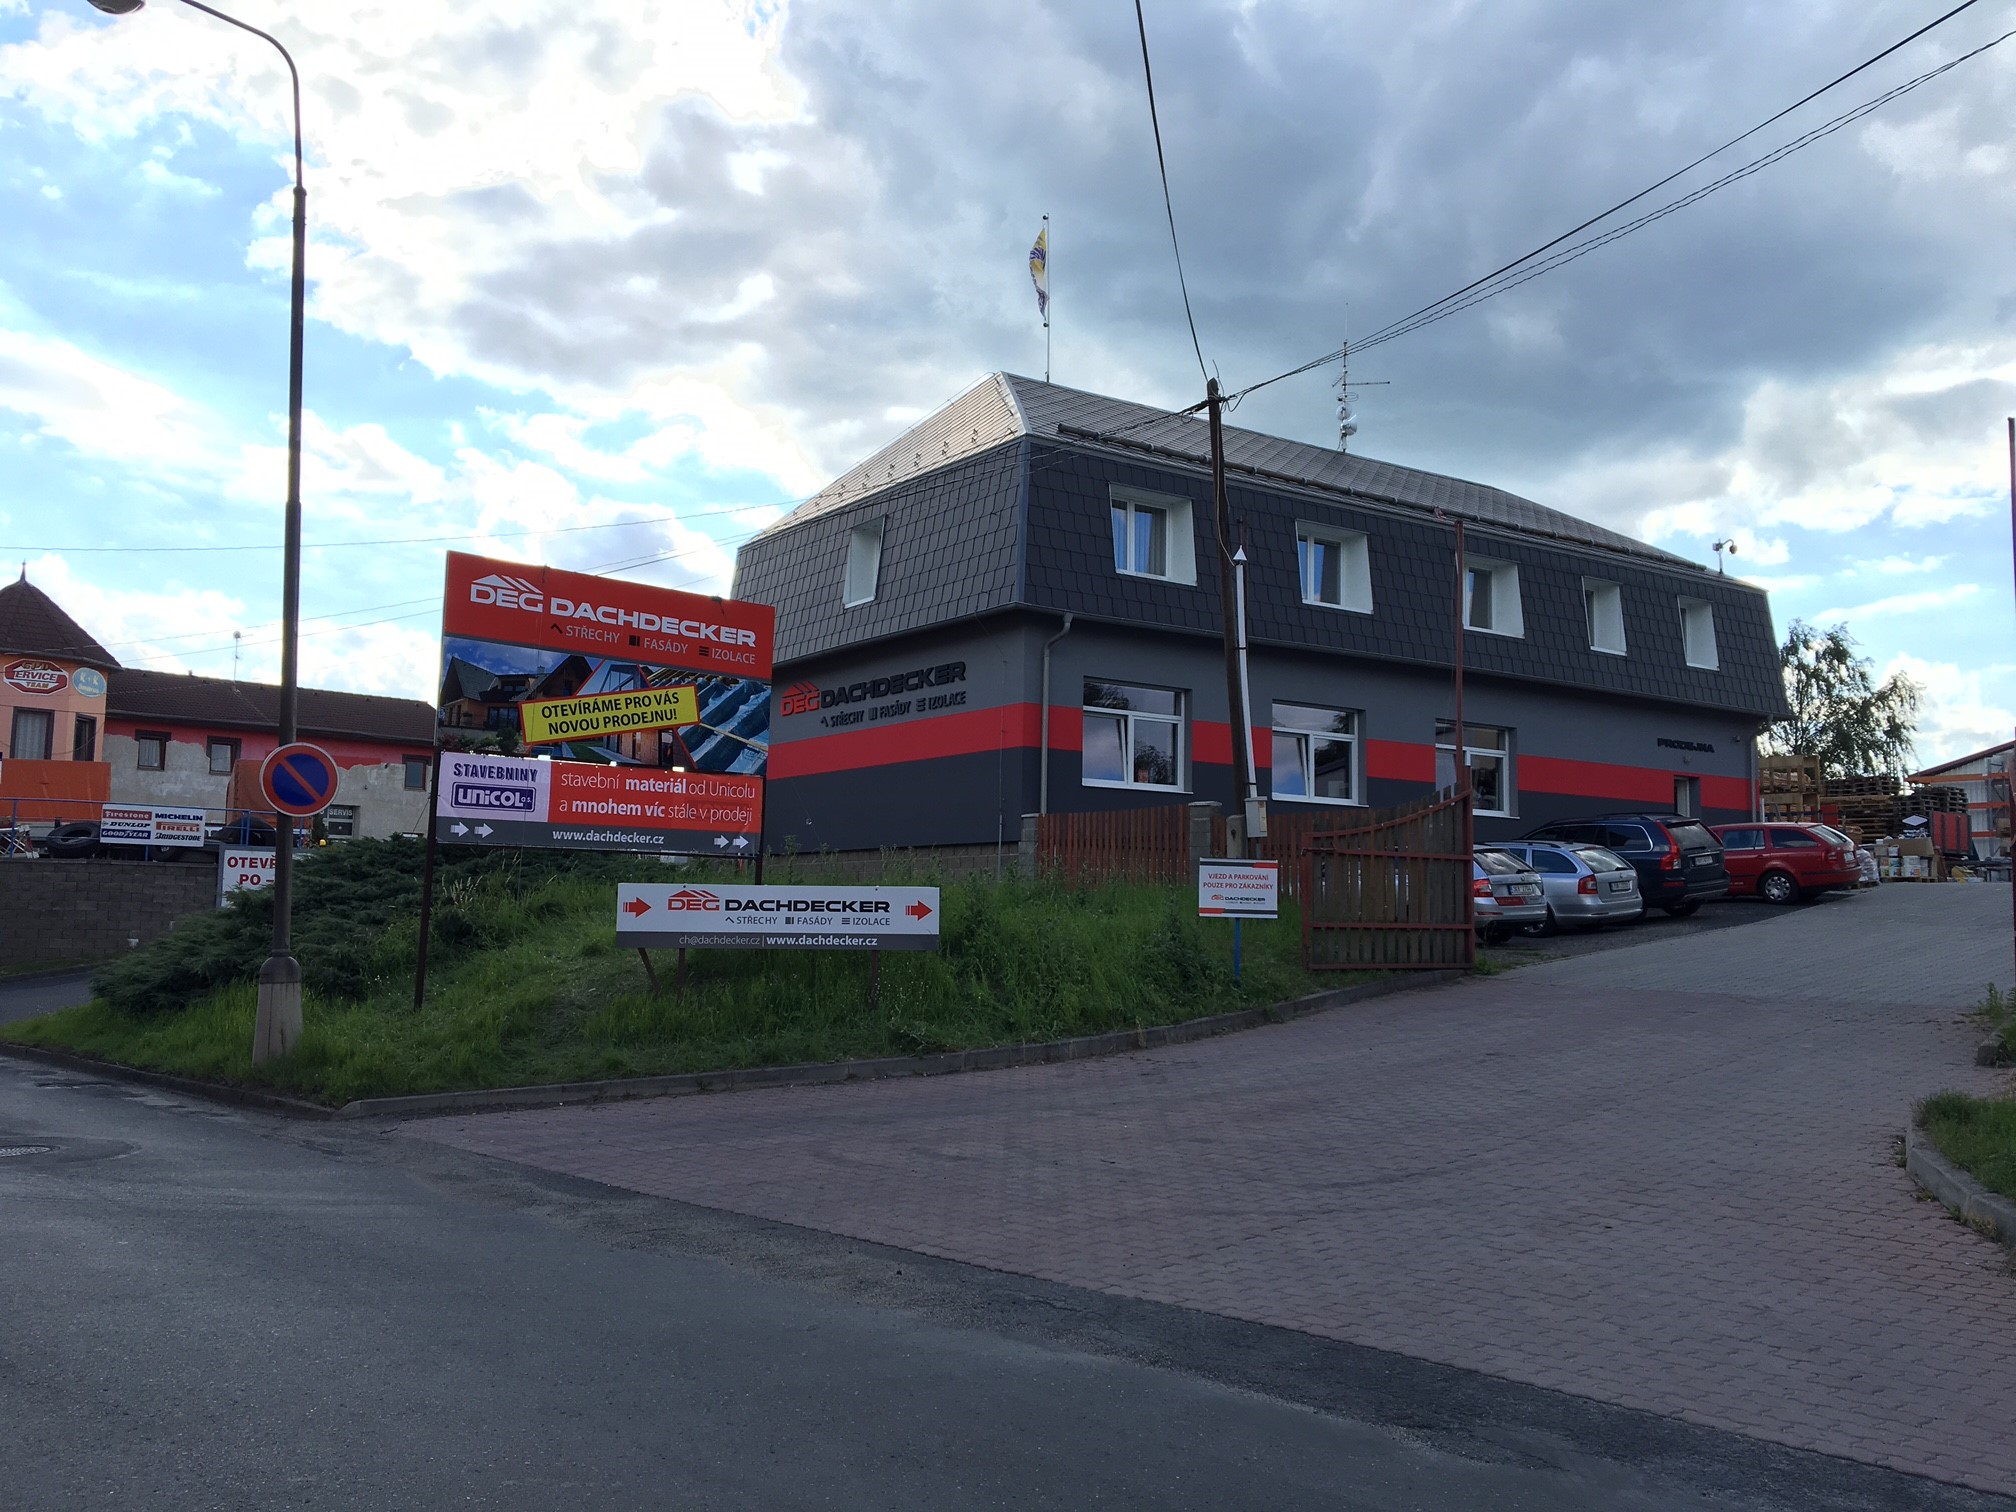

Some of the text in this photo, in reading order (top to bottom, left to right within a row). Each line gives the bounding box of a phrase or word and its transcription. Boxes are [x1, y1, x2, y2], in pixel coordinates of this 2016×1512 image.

[470, 583, 757, 648] DEG DACHDECKER
[565, 624, 756, 665] STŘECHY FASÁDY IZOLACE
[26, 681, 49, 689] TEAM
[780, 661, 967, 717] DEG DACHDECKER
[541, 692, 680, 719] OTEVÍRÁME PRO VÁS
[830, 690, 967, 728] STŘECHY FASÁDY IZOLACE
[548, 708, 678, 735] NOVOU PRODEJNU!
[453, 763, 538, 782] STAVEBNINY
[560, 772, 756, 799] stavební materiál od Unicolu
[104, 810, 150, 819] Firestone
[154, 813, 203, 821] MICHELIN
[328, 808, 353, 817] SERVIS
[559, 799, 754, 826] a mnohem víc stále v prodeji
[102, 830, 148, 838] GOODYEAR
[154, 832, 202, 841] BRIDGESTONE
[552, 829, 665, 845] www.dachdecker.cz
[239, 873, 262, 886] PO
[1233, 873, 1269, 881] PARKOVÁNÍ
[1239, 881, 1274, 890] ZÁKAZNÍKY
[667, 898, 891, 913] DEG DACHDECKER
[736, 914, 891, 926] STŘECHY FASÁDY IZOLACE
[678, 934, 878, 947] ch@dachdecker.cz www.dachdecker.cz
